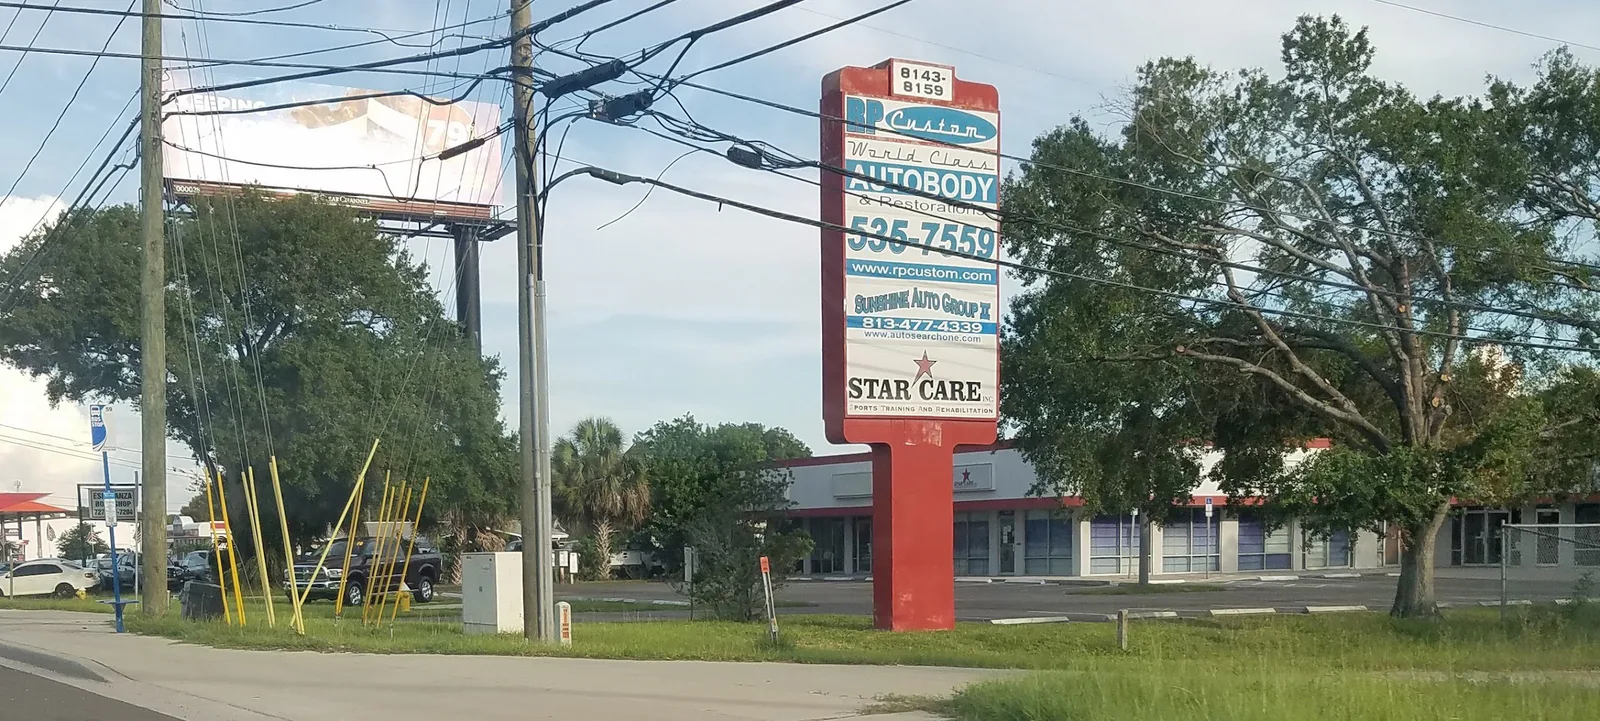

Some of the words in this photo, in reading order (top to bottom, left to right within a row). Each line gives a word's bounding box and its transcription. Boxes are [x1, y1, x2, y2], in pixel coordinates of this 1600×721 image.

[900, 67, 946, 83] 8143-
[903, 80, 944, 96] 8159
[846, 97, 885, 135] RP
[891, 110, 987, 139] Custom
[847, 141, 923, 163] World
[929, 150, 995, 171] Class
[849, 164, 994, 202] AUTOBODY
[859, 193, 872, 206] &
[879, 196, 986, 216] Restorations
[848, 216, 995, 258] 535-7559
[852, 263, 992, 281] www.rpcustom.com
[854, 290, 910, 315] SUNSHINE
[911, 287, 941, 311] AUTO
[942, 293, 979, 318] GROUP
[862, 318, 983, 333] 813-477-4339
[864, 330, 981, 343] www.autosearchone.com
[848, 377, 912, 400] STAR
[918, 379, 982, 402] CARE
[935, 406, 994, 414] REHABILITATION
[93, 492, 132, 500] ESANZA
